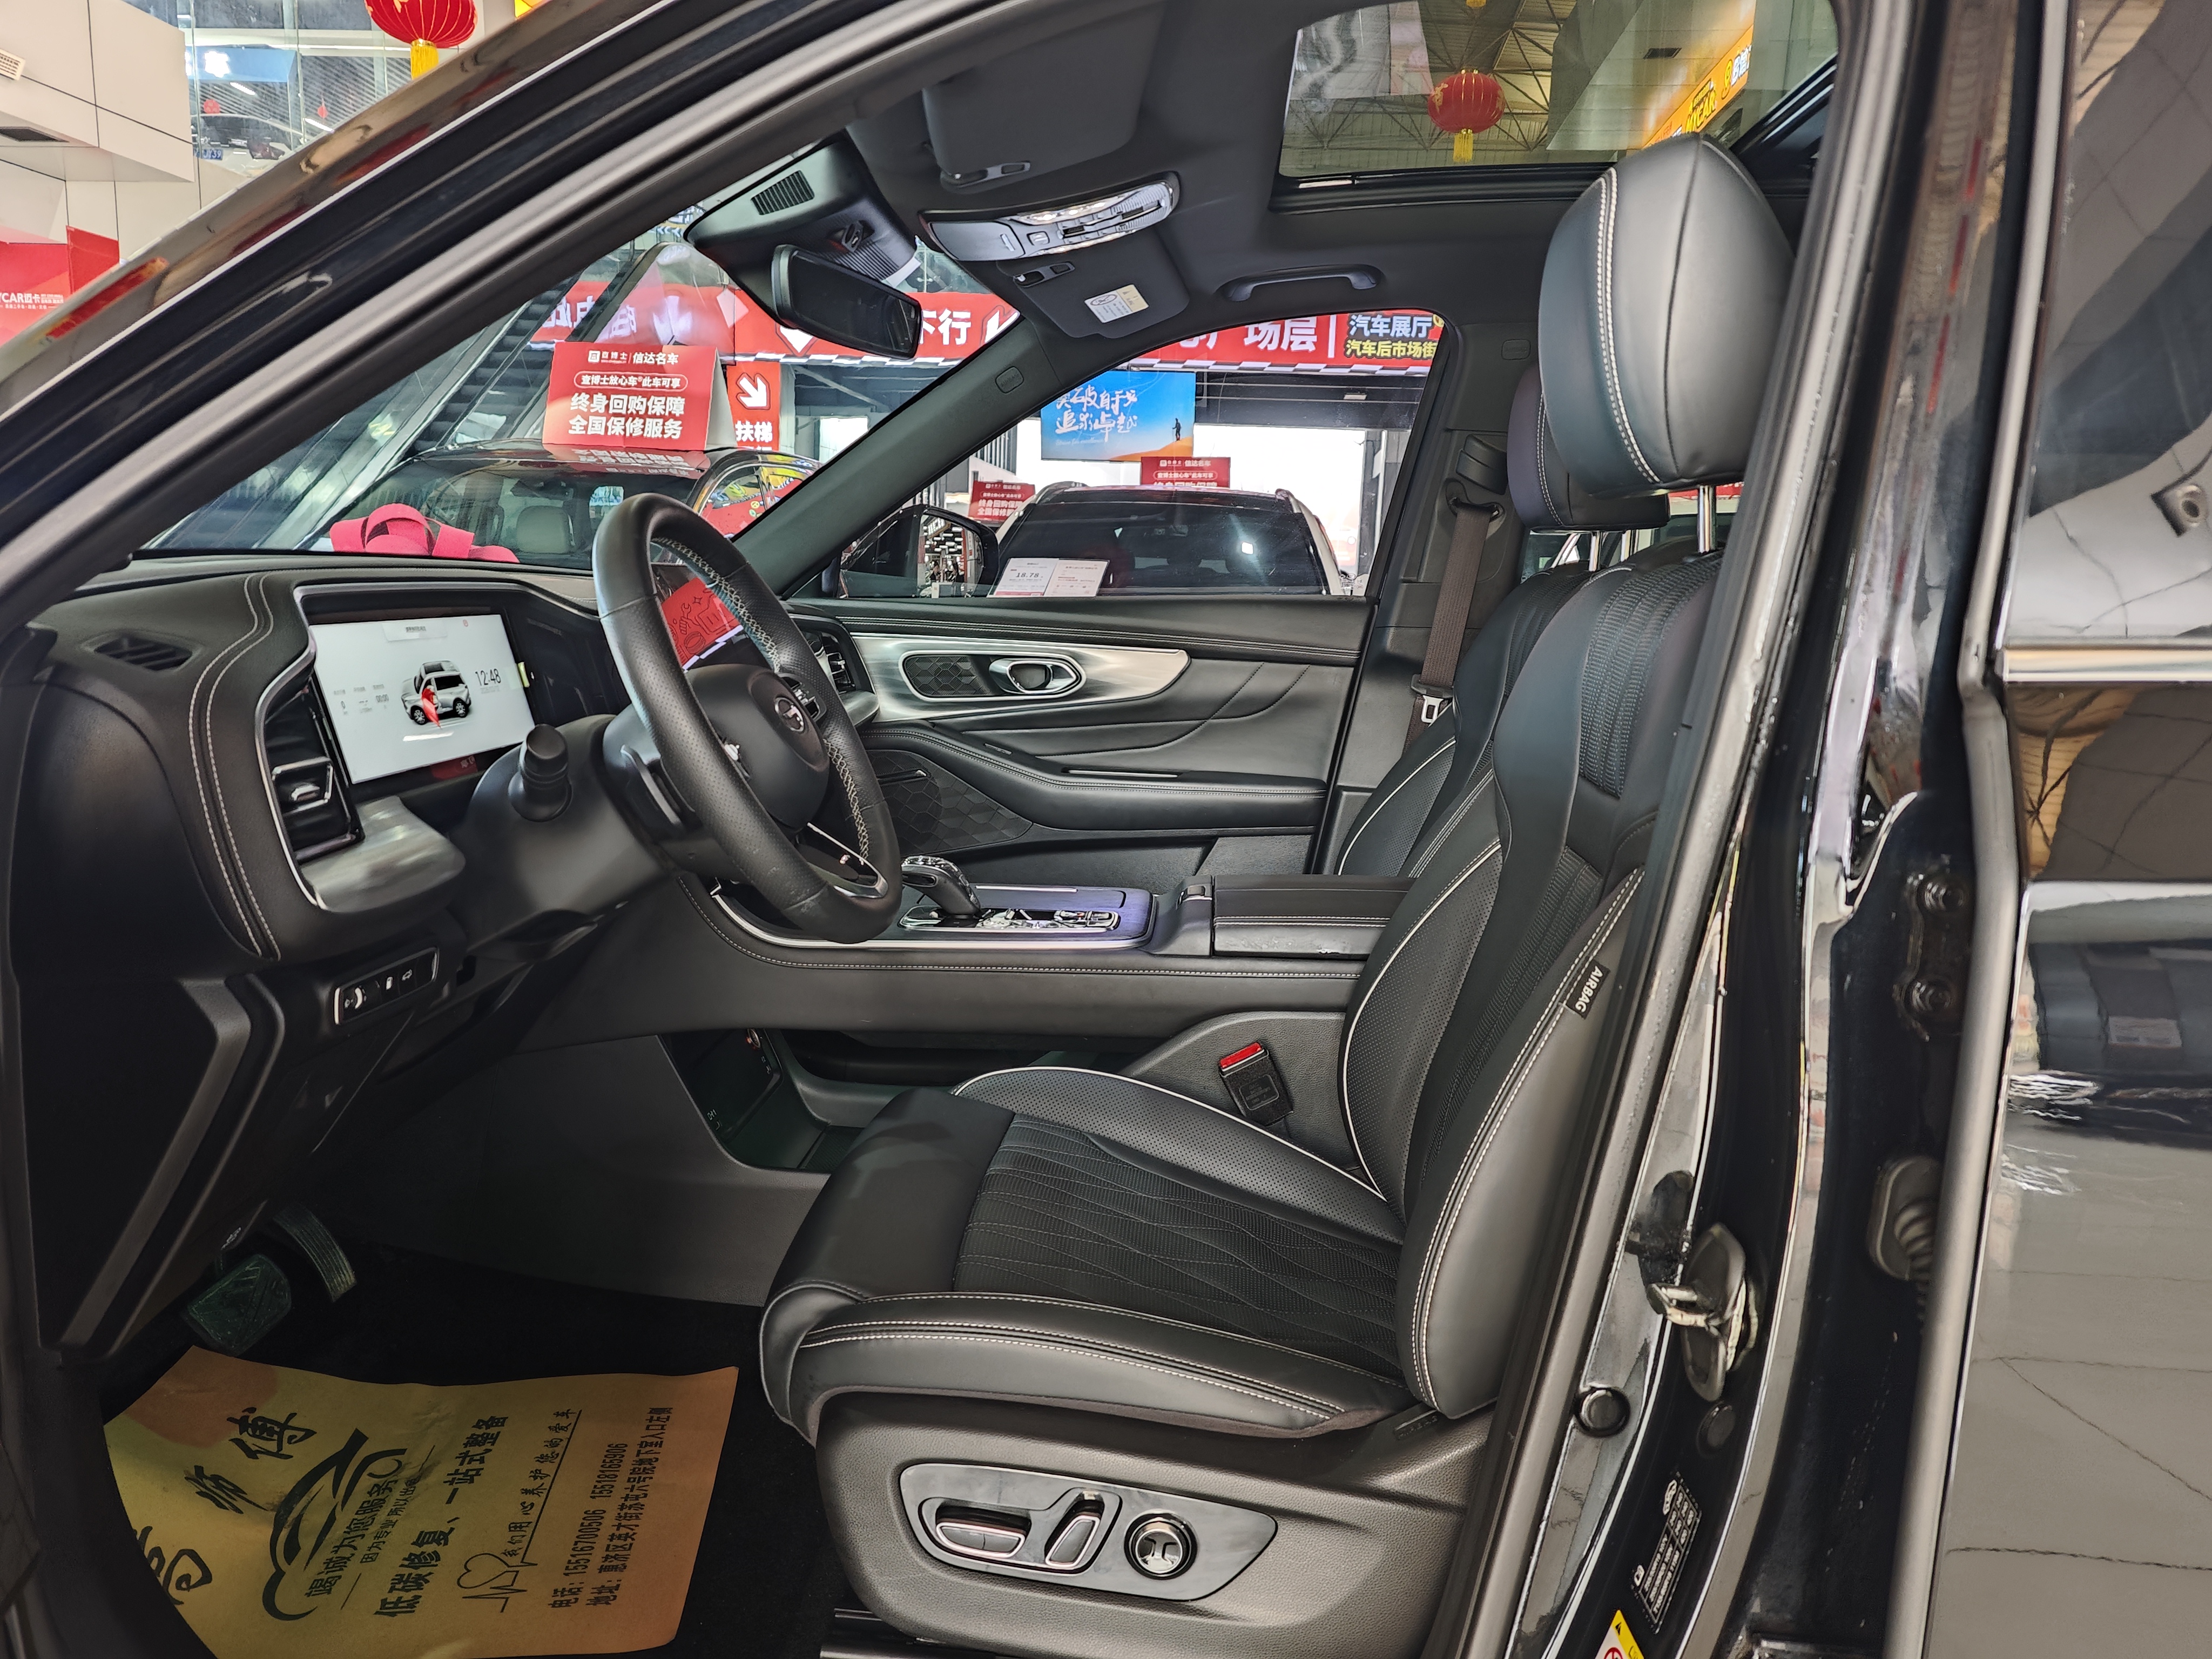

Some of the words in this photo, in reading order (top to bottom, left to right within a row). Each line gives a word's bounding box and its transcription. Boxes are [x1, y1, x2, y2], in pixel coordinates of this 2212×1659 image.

[1350, 314, 1432, 338] 汽车展厅
[633, 352, 679, 365] 信达名车
[1346, 339, 1438, 358] 汽车后市场街
[570, 393, 685, 416] 终身回购保障
[568, 415, 683, 439] 全国保修服务
[735, 420, 773, 442] 扶梯
[475, 668, 501, 686] 12:48
[1575, 966, 1603, 1013] AIRBAG
[501, 1408, 577, 1557] 我们用心养护您的爱车
[590, 1443, 628, 1499] 15518165906
[373, 1416, 509, 1617] 低碳修复、一站式整备
[304, 1479, 398, 1597] 竭诚为您服务
